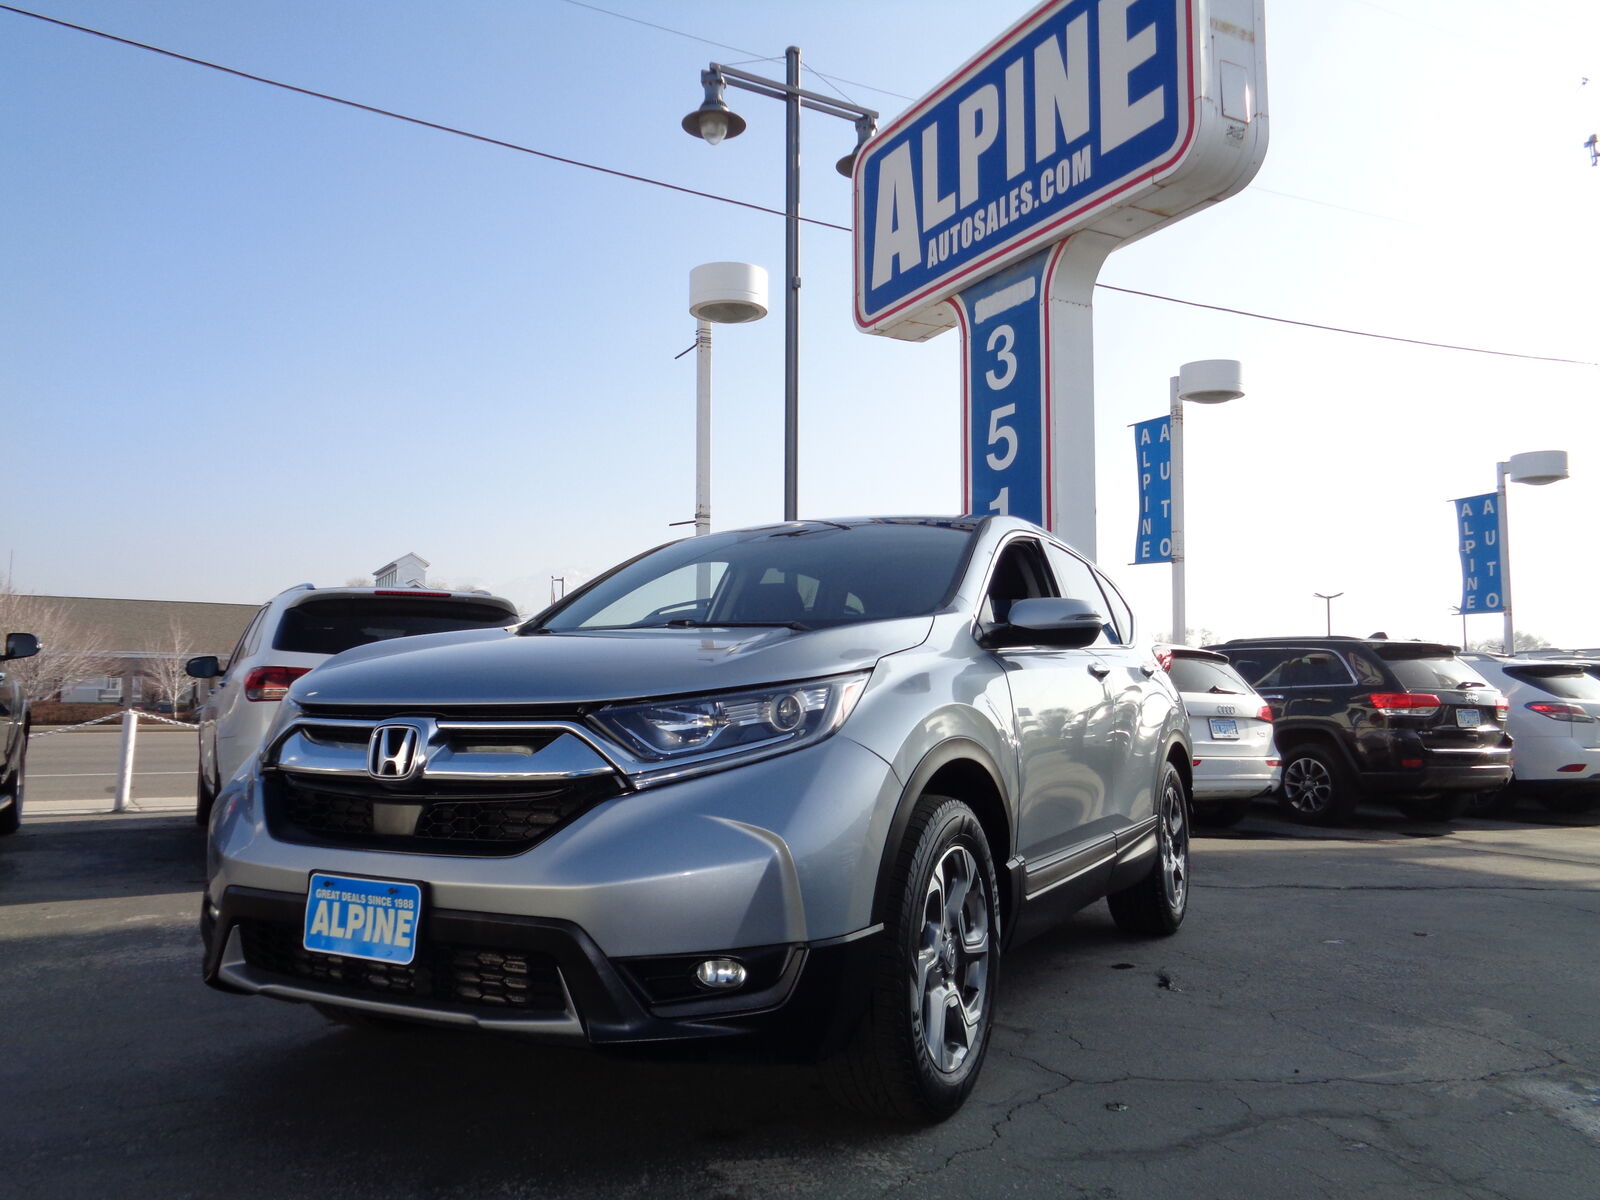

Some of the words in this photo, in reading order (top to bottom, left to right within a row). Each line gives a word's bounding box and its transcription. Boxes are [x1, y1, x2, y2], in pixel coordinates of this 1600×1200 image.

[872, 0, 1165, 291] ALPINE
[926, 144, 1092, 270] AUTOSALES.COM
[1140, 428, 1152, 558] ALPINE
[1159, 423, 1172, 557] AUTO
[1461, 502, 1479, 609] ALPINE
[1482, 499, 1499, 608] AUTO
[310, 899, 414, 948] ALPINE
[315, 888, 341, 901] GREAT
[341, 891, 366, 904] DEALS
[367, 894, 392, 907] SINCE
[394, 898, 415, 910] 1988
